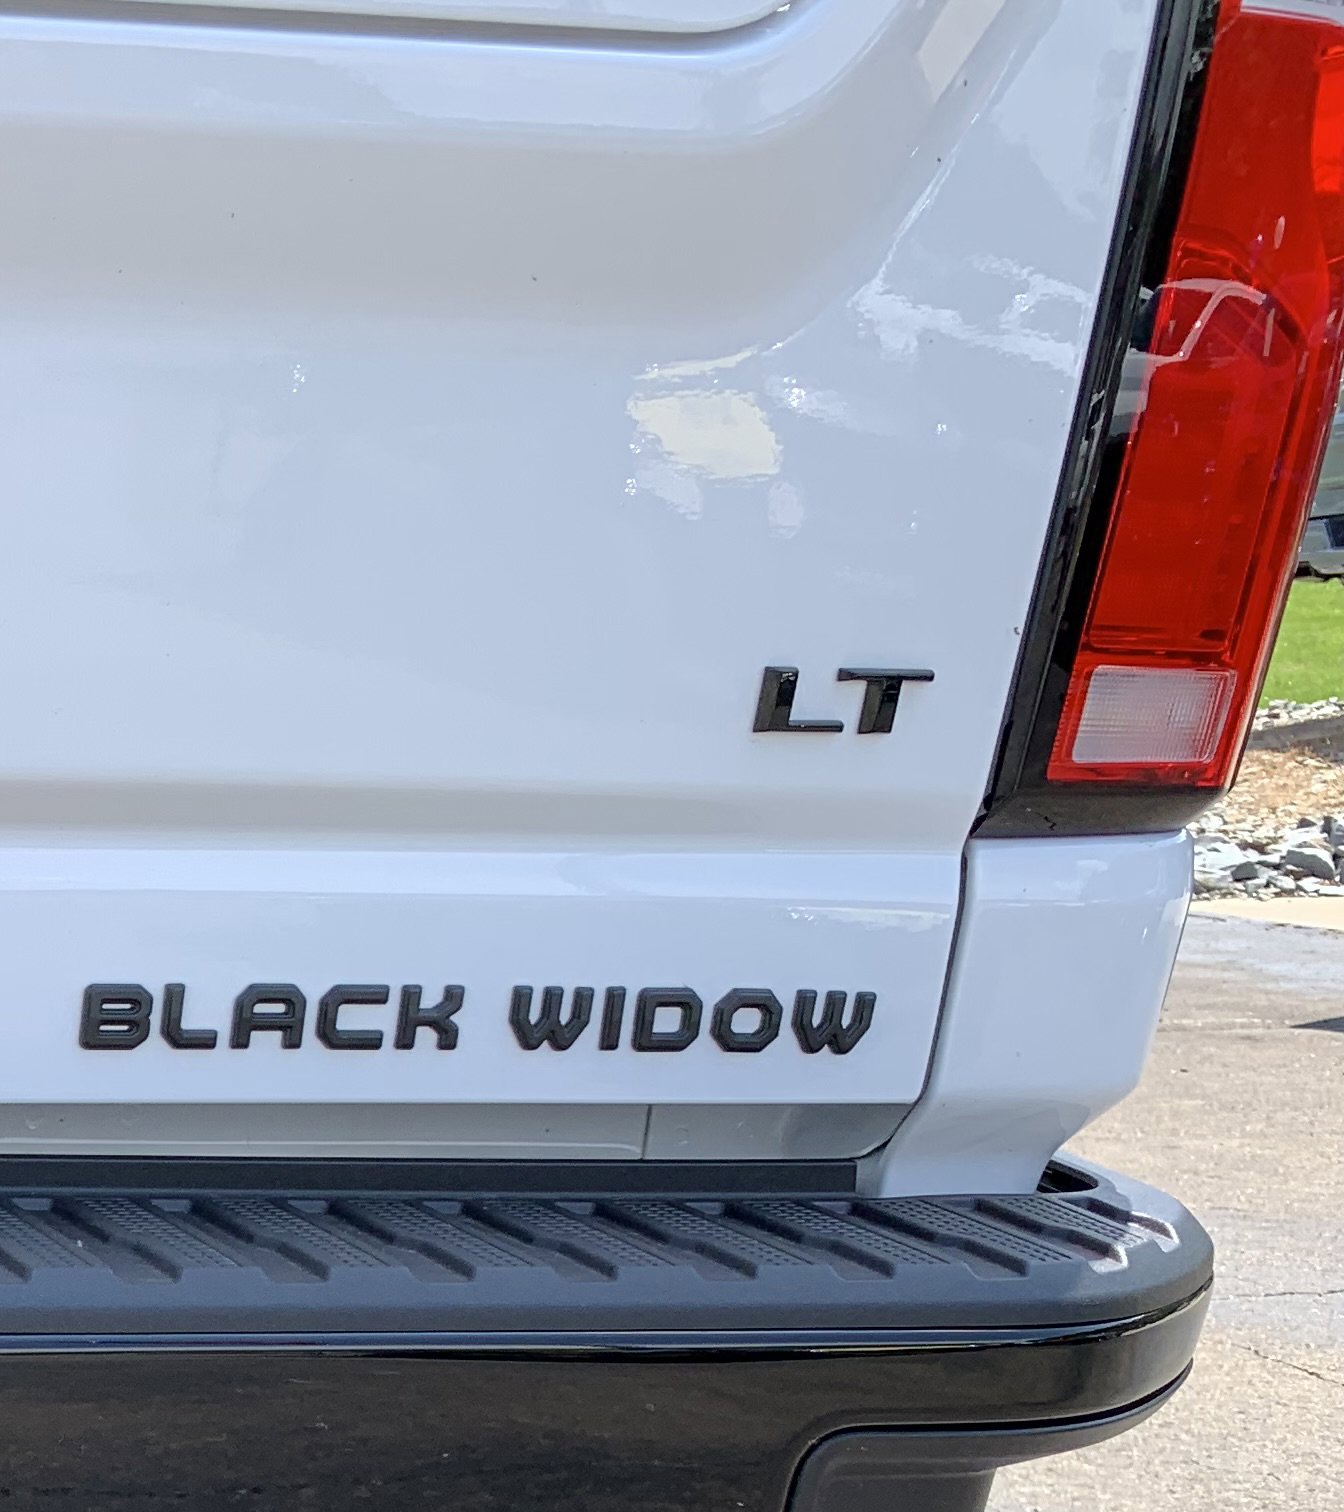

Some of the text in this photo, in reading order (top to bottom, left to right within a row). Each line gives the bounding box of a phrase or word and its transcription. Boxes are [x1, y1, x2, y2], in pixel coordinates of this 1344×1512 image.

[752, 665, 936, 735] LT
[77, 982, 879, 1056] BLACK WIDOW
